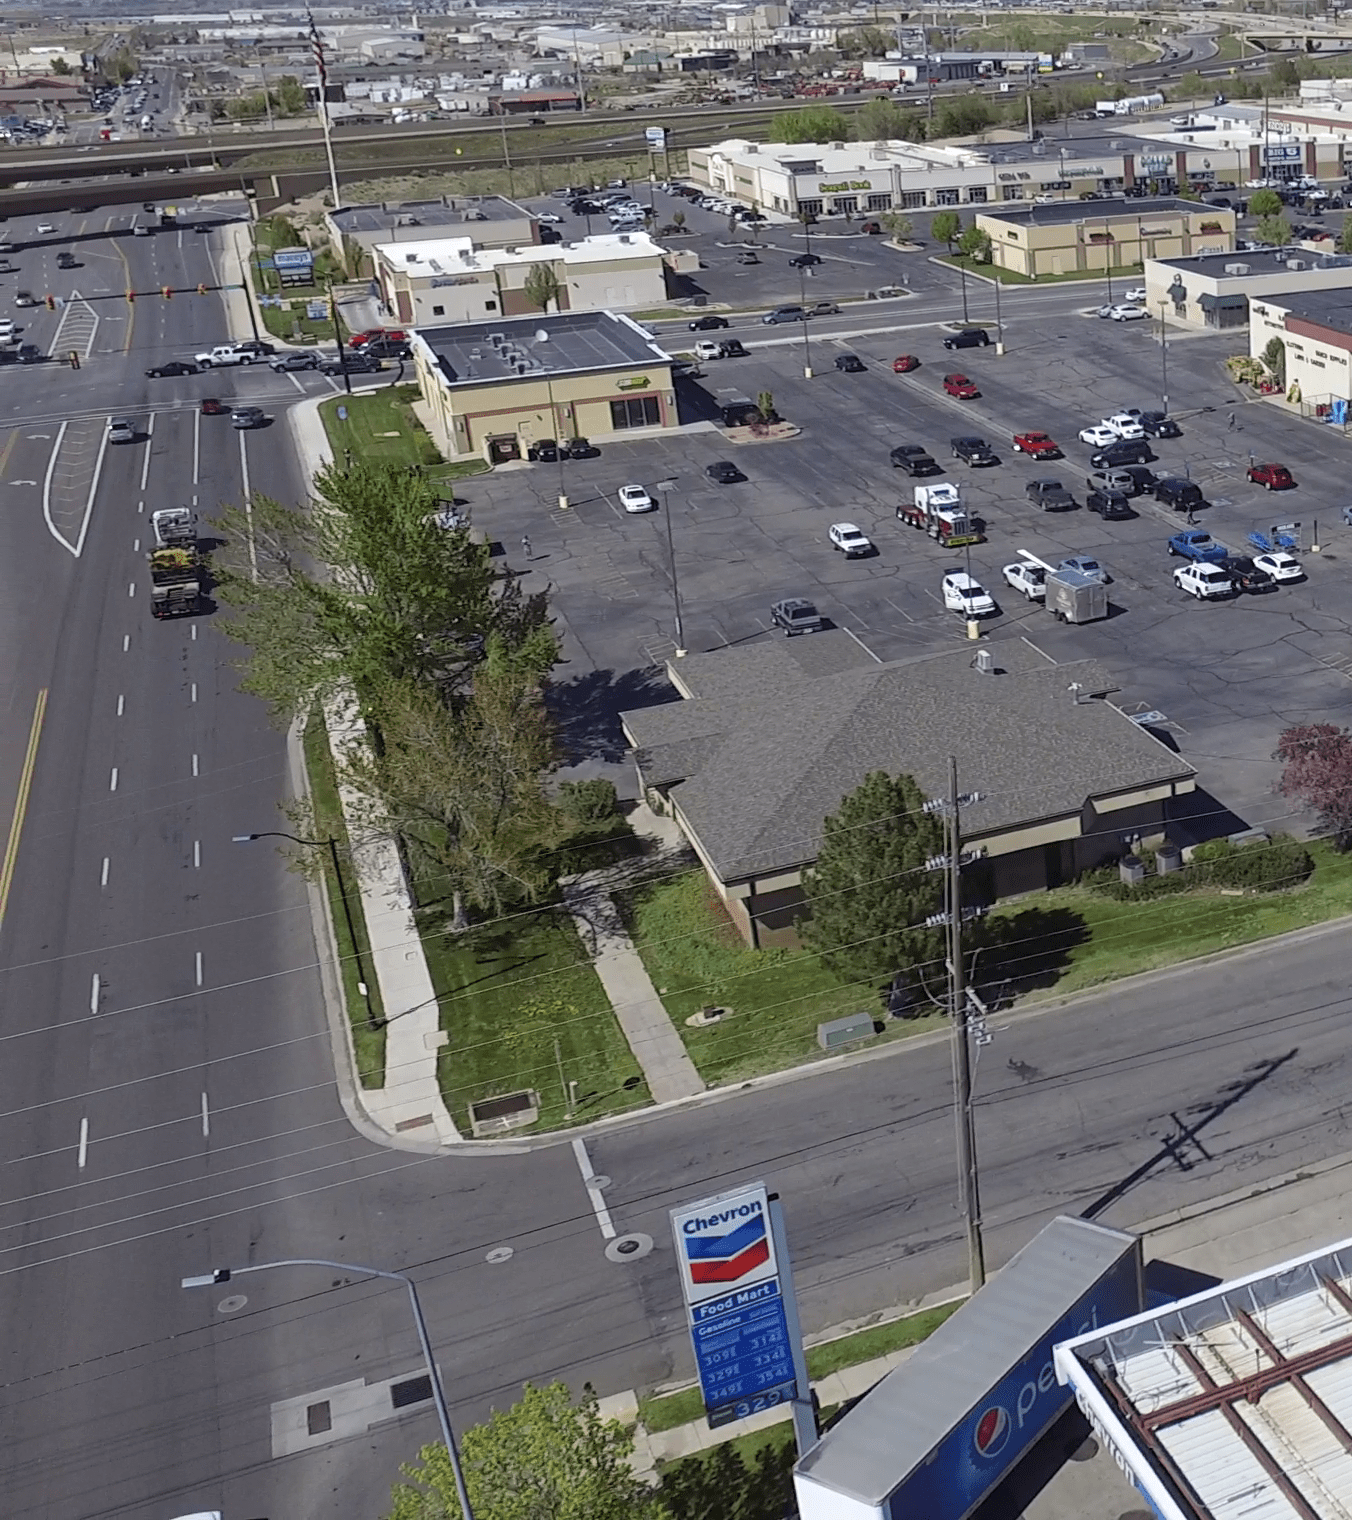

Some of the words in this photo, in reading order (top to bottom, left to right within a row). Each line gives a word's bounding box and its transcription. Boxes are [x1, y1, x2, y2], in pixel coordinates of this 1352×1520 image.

[682, 1200, 763, 1234] Chevron
[700, 1298, 734, 1318] Food
[736, 1285, 771, 1304] Mart
[698, 1316, 741, 1336] Gasoline
